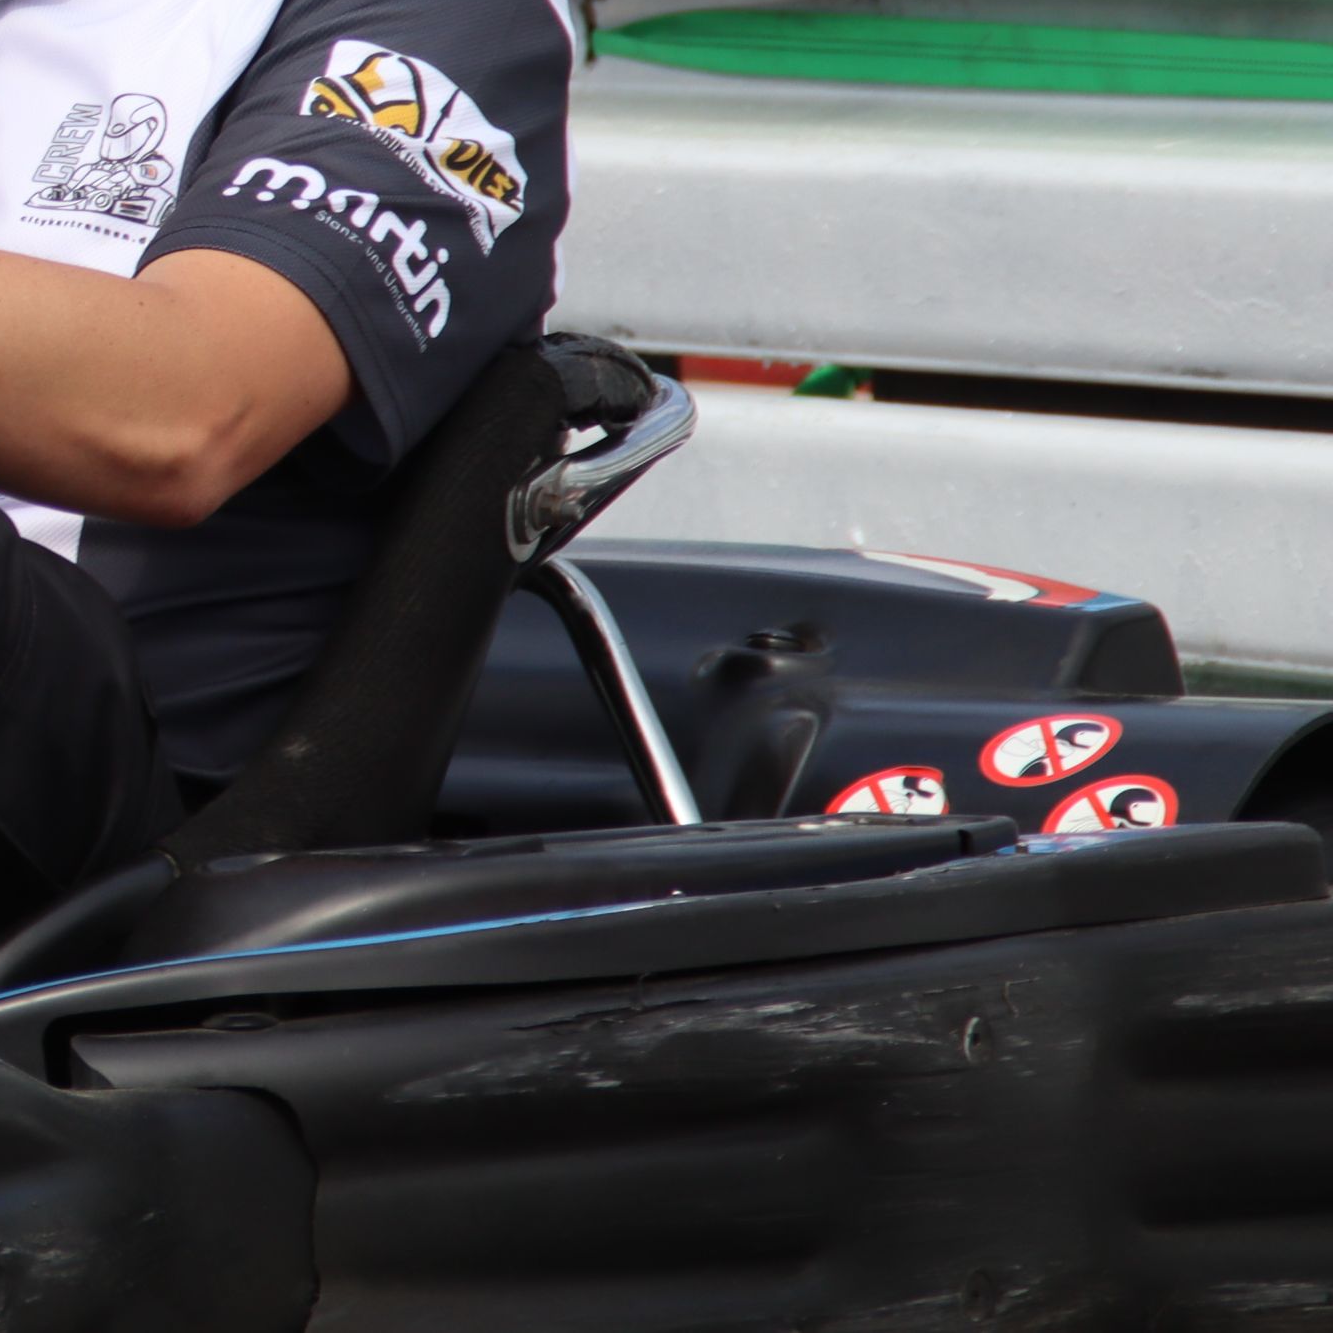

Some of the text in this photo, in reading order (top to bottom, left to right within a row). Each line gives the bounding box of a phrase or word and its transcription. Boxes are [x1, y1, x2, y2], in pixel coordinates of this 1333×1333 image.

[32, 103, 103, 185] CREW
[222, 157, 451, 338] martin
[314, 210, 428, 354] Stanz- und Umformteile
